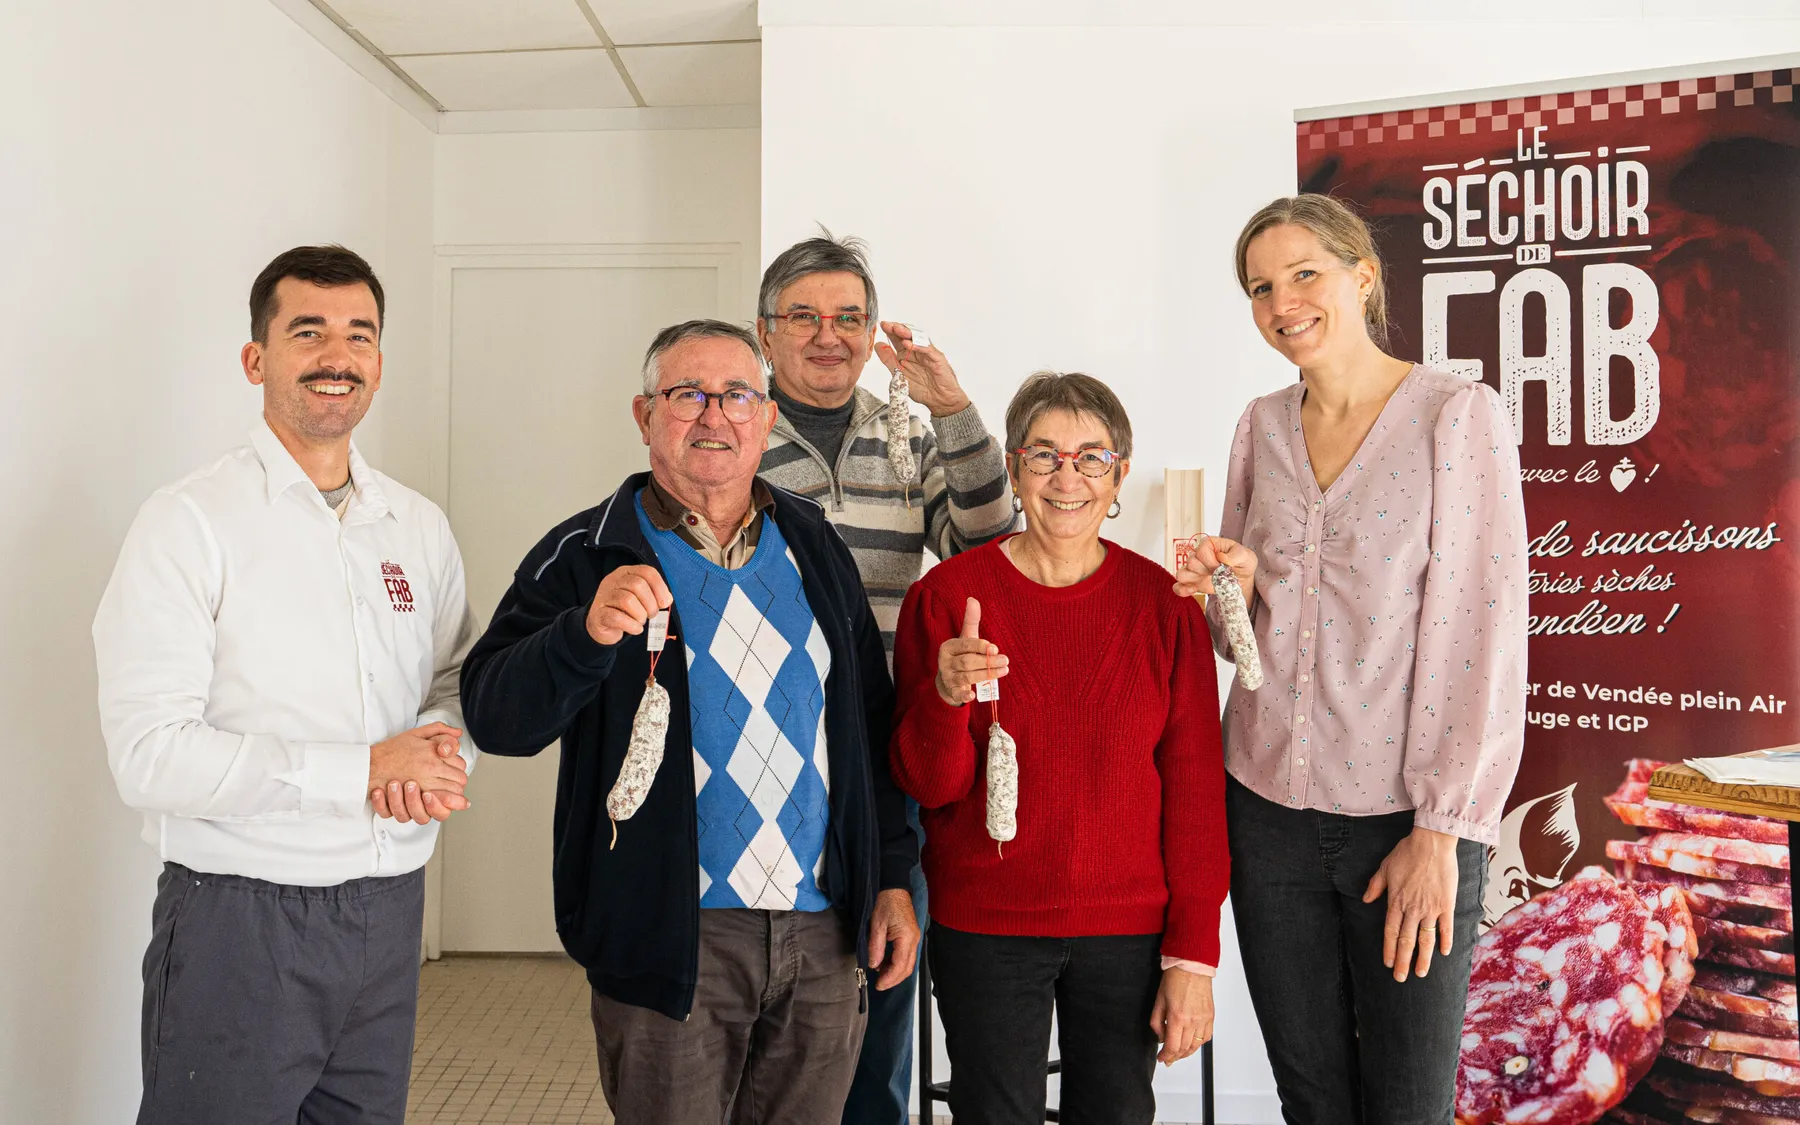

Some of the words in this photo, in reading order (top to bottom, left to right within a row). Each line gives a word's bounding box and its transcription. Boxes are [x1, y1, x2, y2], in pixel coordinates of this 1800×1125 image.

[1517, 125, 1549, 162] LE
[1422, 146, 1650, 250] SÉCHOIR
[1520, 247, 1547, 262] DE
[1422, 262, 1661, 446] FAB
[1519, 469, 1569, 482] avec
[1574, 459, 1601, 483] le
[1644, 463, 1660, 483] !
[1528, 519, 1574, 558] de
[1581, 519, 1782, 558] saucissons
[384, 579, 414, 603] FAB
[1590, 564, 1676, 593] sèches
[1656, 603, 1680, 633] !
[1547, 680, 1577, 699] de
[1582, 683, 1673, 706] Vendée
[1680, 690, 1741, 711] plein
[1748, 694, 1787, 714] Air
[1525, 711, 1571, 730] uge
[1577, 713, 1601, 730] et
[1608, 713, 1649, 733] IGP
